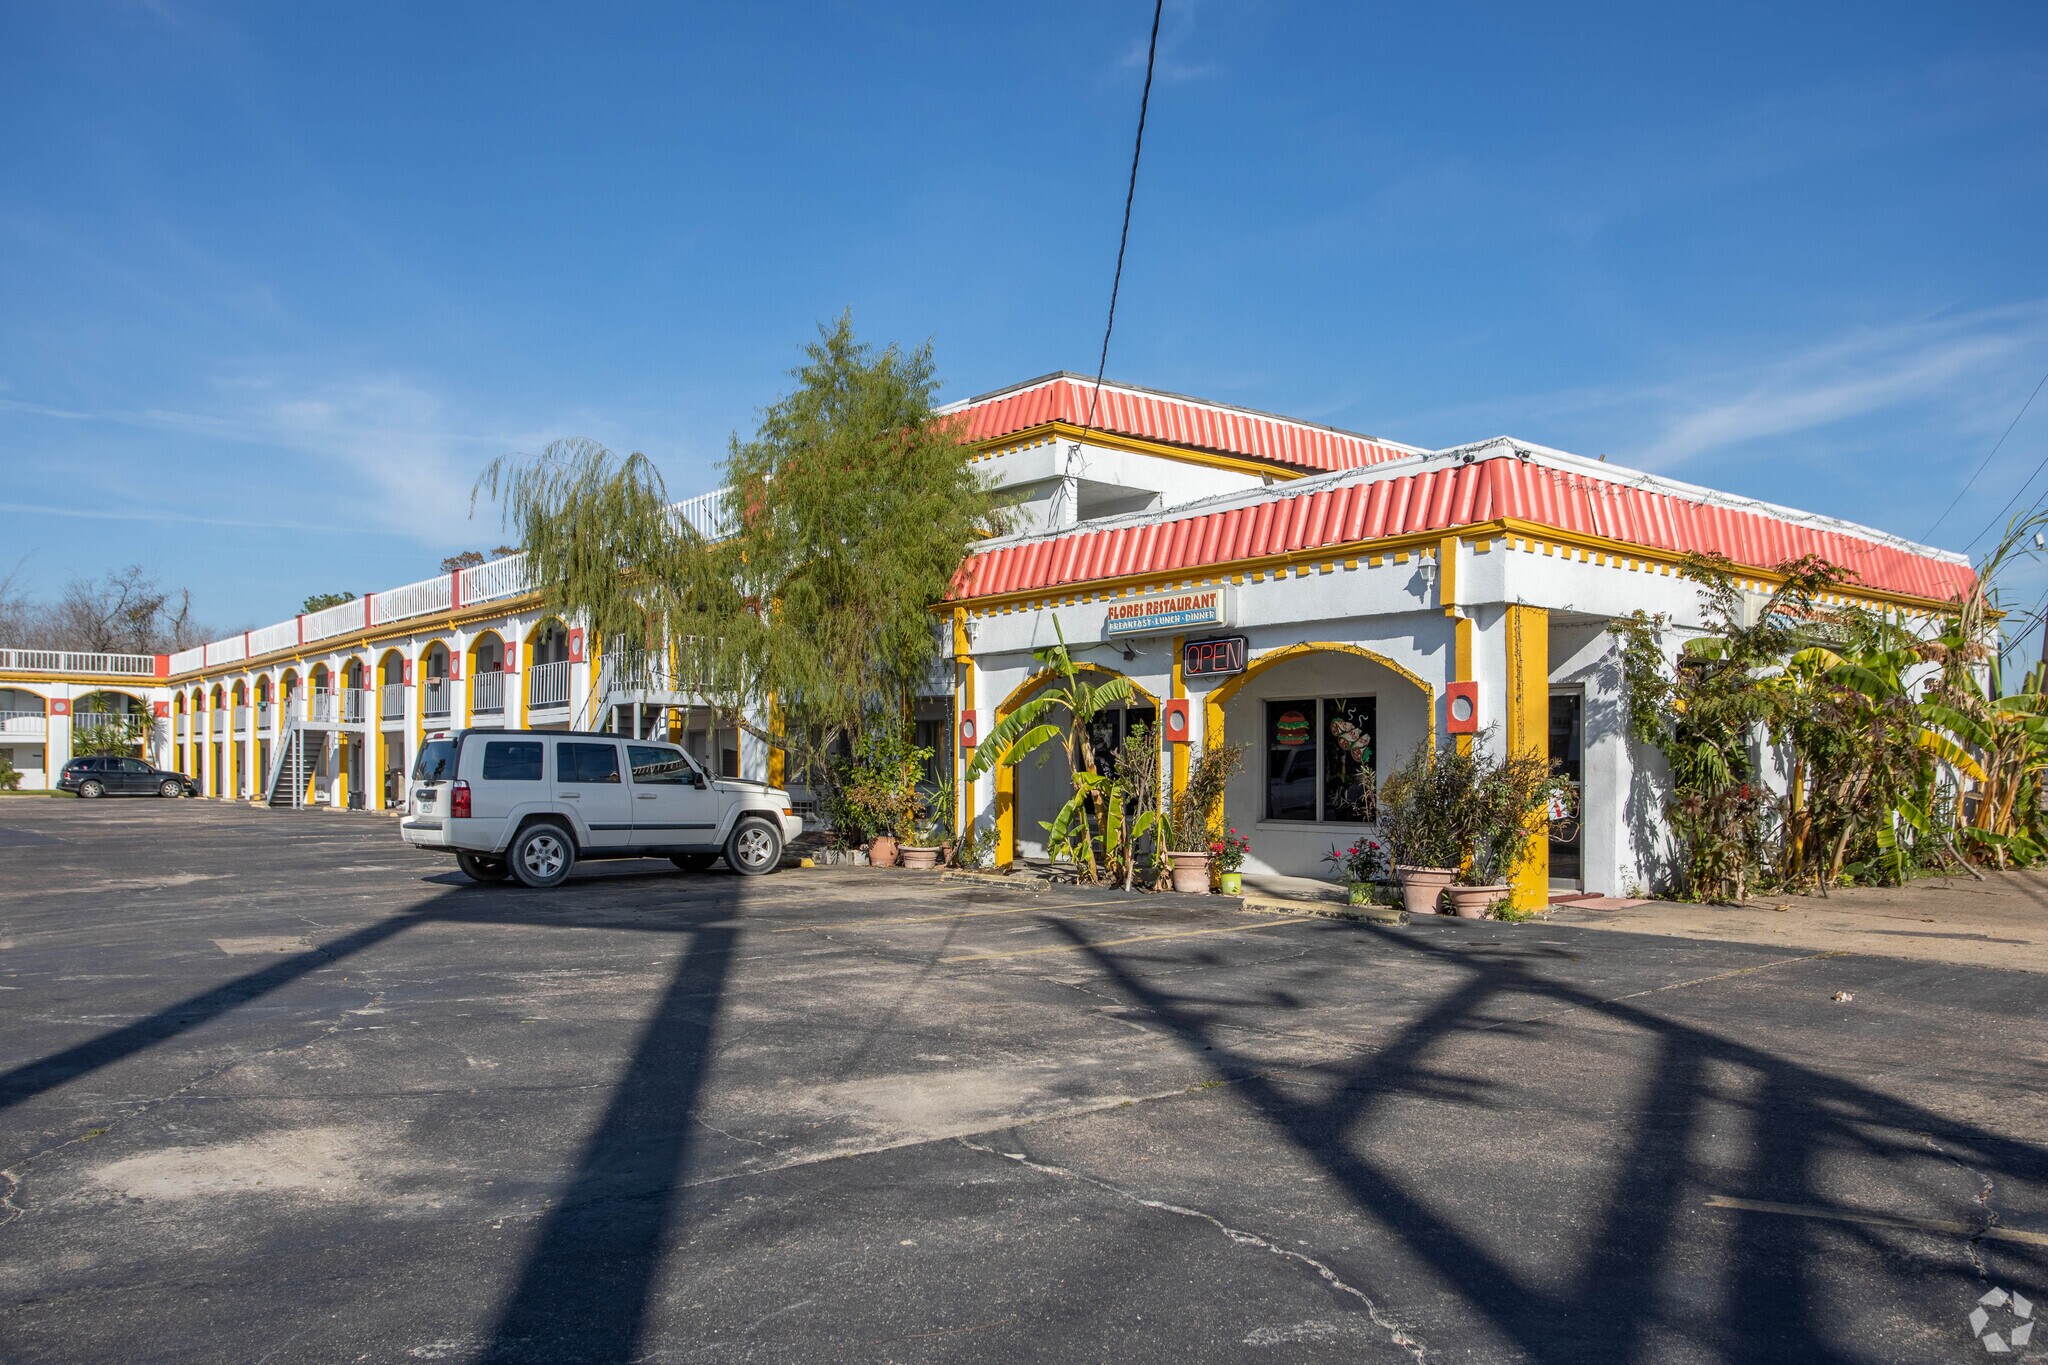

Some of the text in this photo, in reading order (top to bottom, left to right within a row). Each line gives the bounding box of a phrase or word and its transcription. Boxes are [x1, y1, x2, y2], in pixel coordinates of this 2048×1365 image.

[1108, 593, 1216, 620] FLORES RESTAURANT
[1110, 610, 1215, 630] BREAKFAST LUNCH DINNER
[1187, 641, 1241, 673] OPEN
